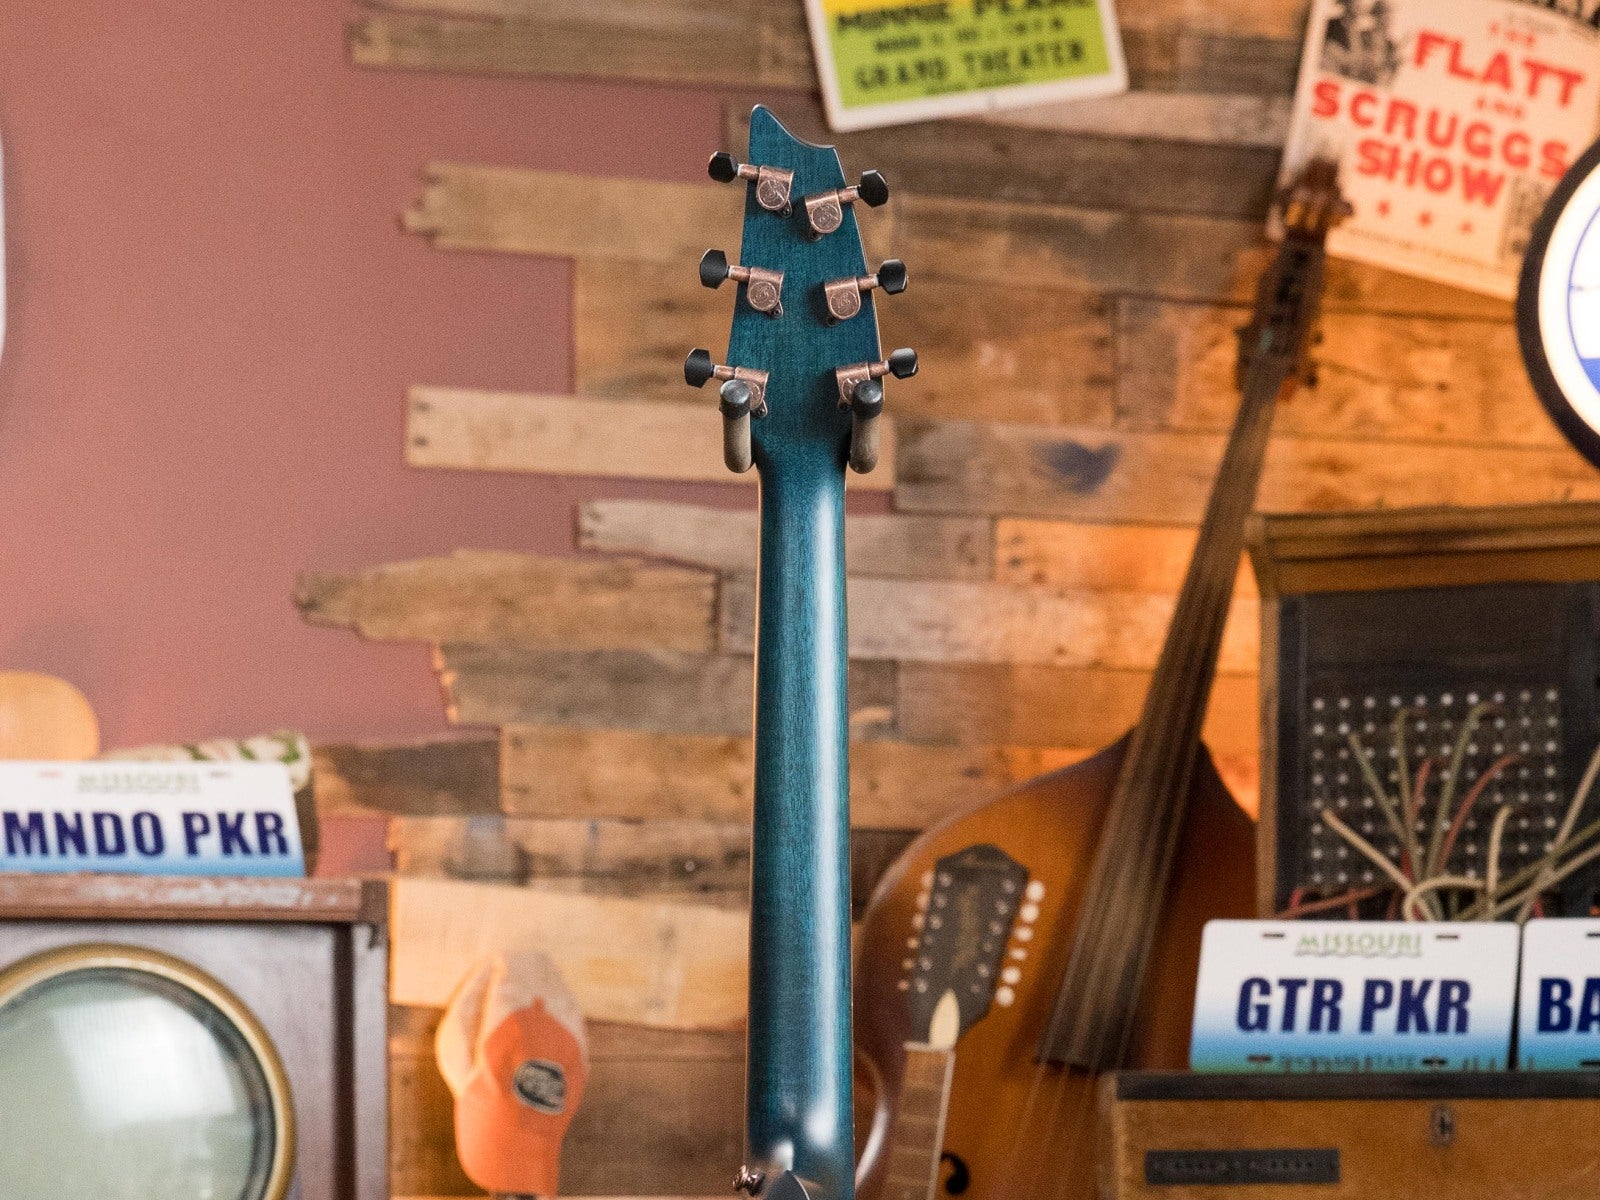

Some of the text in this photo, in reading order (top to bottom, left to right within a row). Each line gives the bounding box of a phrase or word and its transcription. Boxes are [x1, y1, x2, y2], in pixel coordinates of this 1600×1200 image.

[854, 57, 948, 91] GRAND
[963, 40, 1085, 77] THEATER
[1413, 28, 1585, 107] FLATT
[1311, 77, 1571, 180] SCRUGGS
[1356, 138, 1505, 208] SHOW
[2, 811, 292, 857] MNDO PKR
[1298, 932, 1424, 955] MISSOURI
[1236, 977, 1472, 1035] GTR PKR
[1537, 977, 1600, 1034] BA
